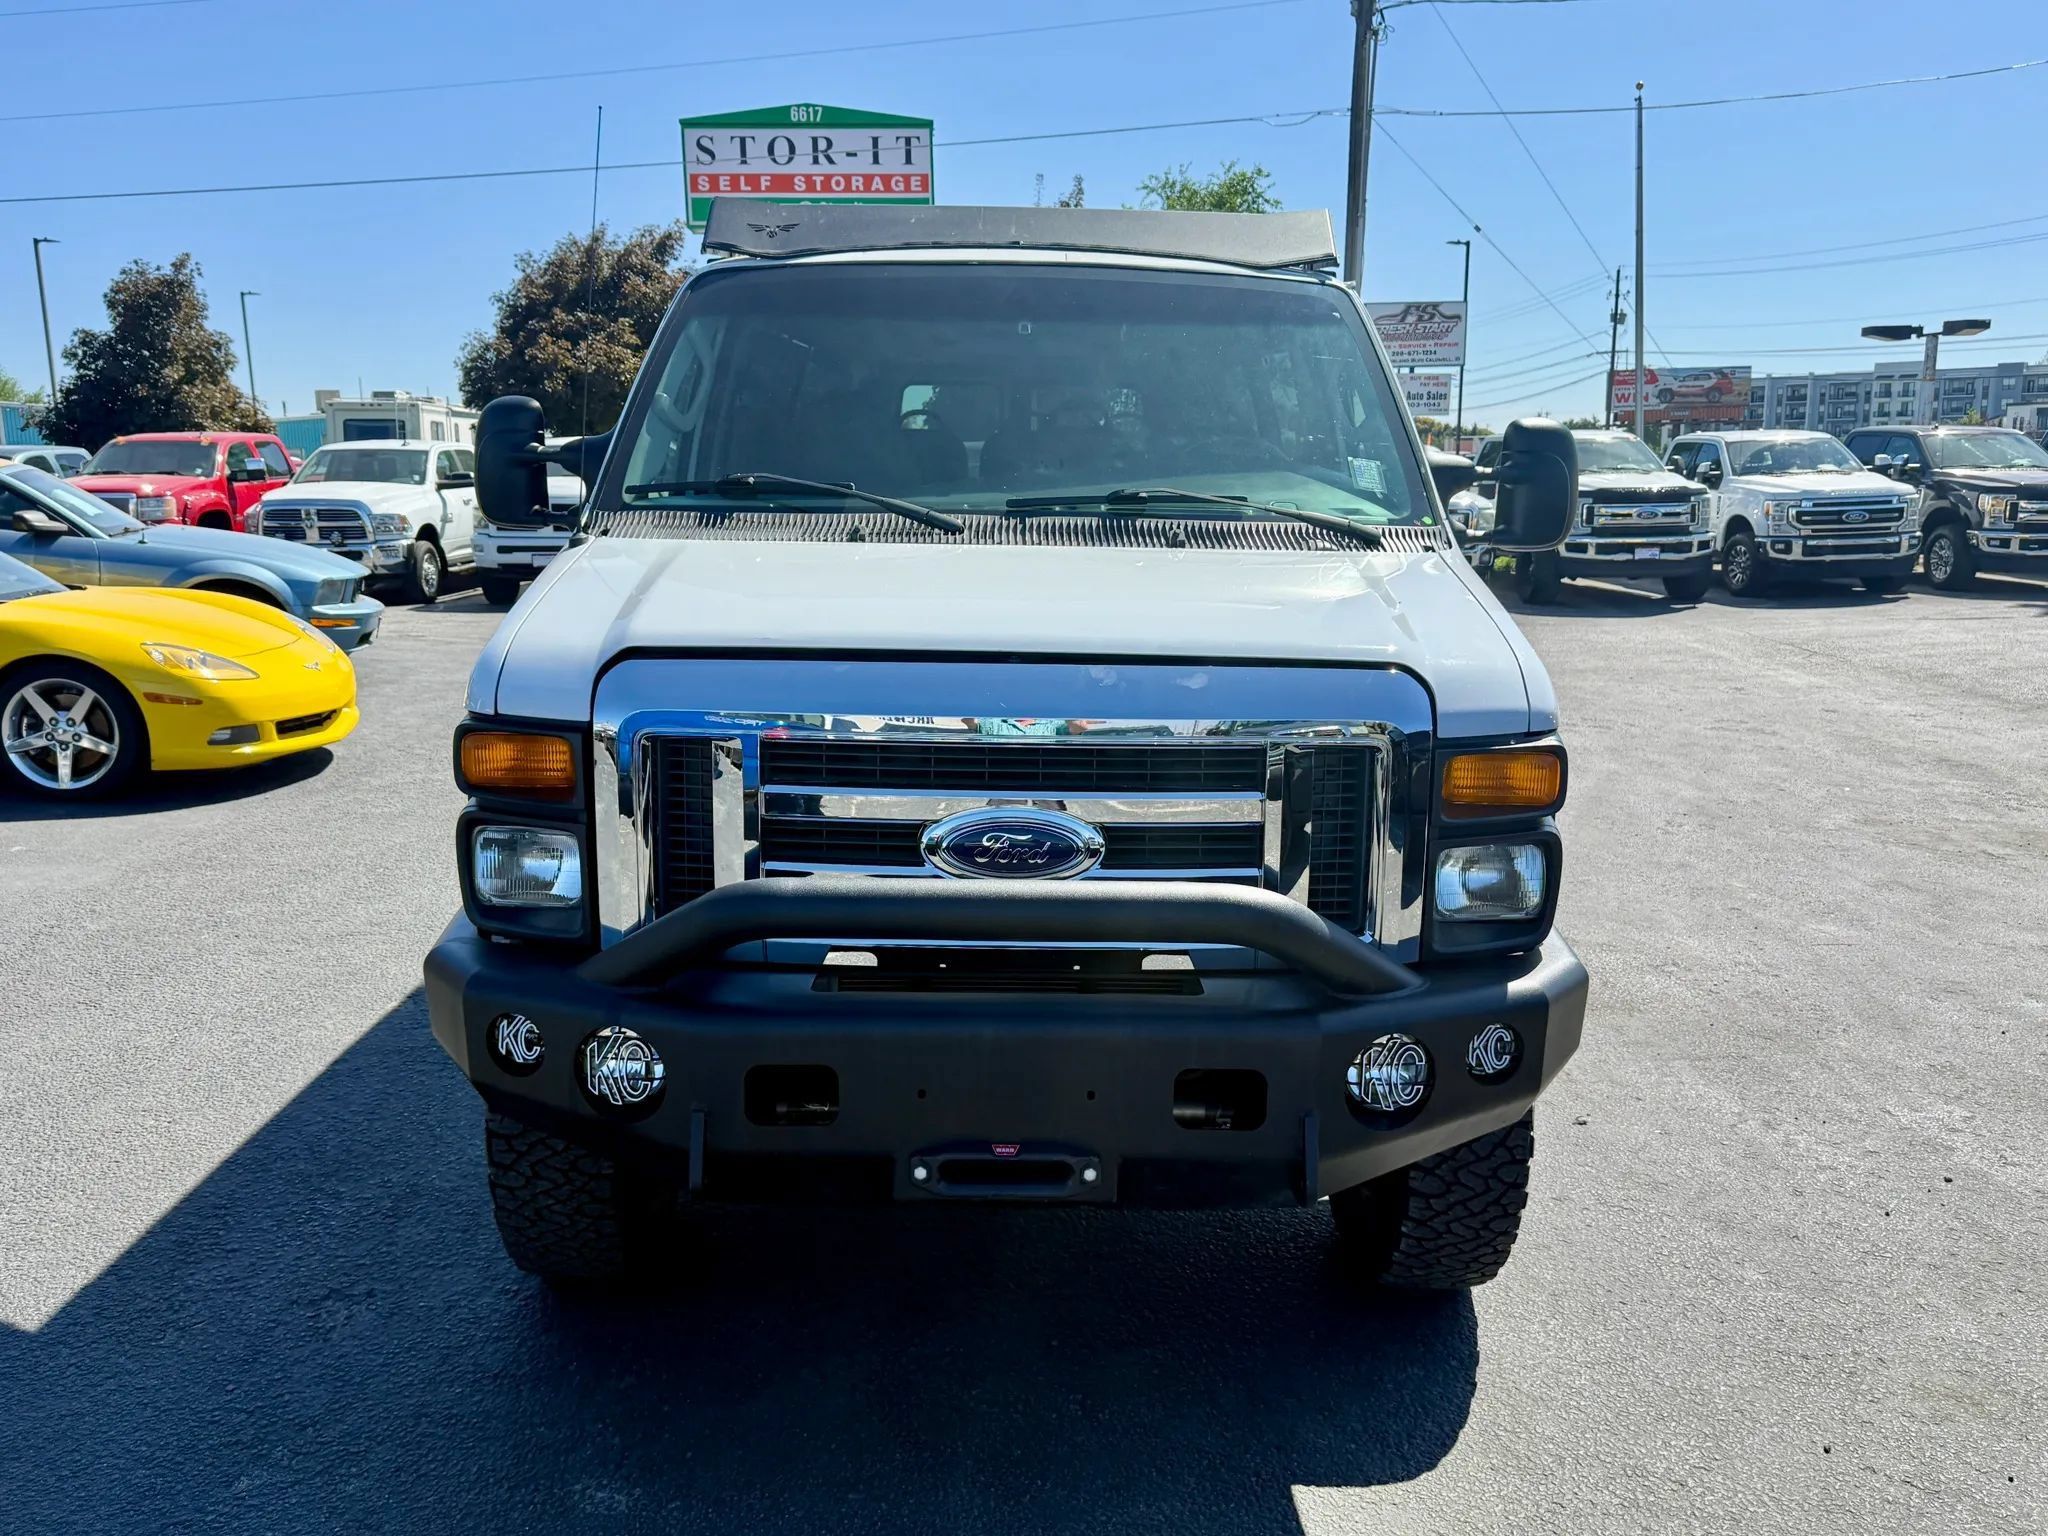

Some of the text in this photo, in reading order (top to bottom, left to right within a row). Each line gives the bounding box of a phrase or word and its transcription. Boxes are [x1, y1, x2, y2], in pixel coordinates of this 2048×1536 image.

[790, 106, 823, 123] 6617
[695, 134, 921, 167] STOR-IT
[697, 175, 923, 192] SELF STORAGE
[1416, 322, 1458, 334] START
[1406, 391, 1448, 401] Auto Sales
[973, 832, 1051, 864] Ford
[498, 1013, 541, 1063] KC
[1468, 1024, 1512, 1074] KC
[587, 1033, 651, 1105] KC
[1361, 1039, 1425, 1111] KC
